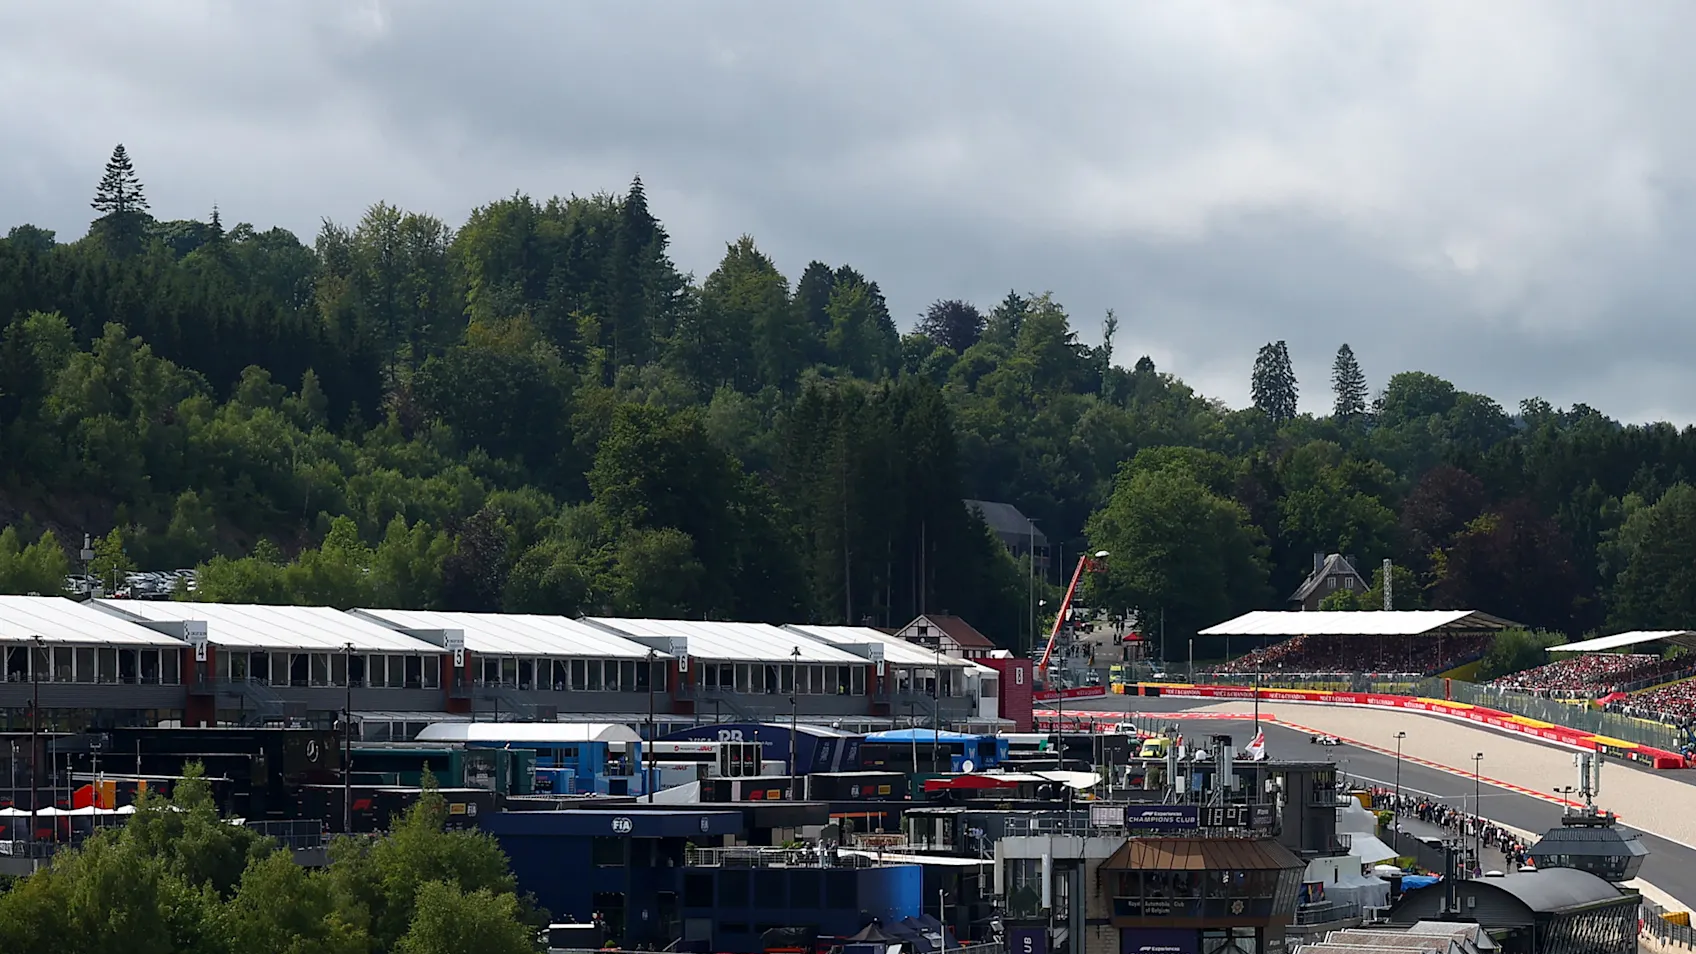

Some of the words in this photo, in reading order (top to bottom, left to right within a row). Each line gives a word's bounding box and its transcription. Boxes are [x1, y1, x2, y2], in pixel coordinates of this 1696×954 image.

[197, 642, 205, 659] 4
[456, 649, 462, 665] 5
[680, 655, 686, 669] 6
[878, 660, 884, 674] 7
